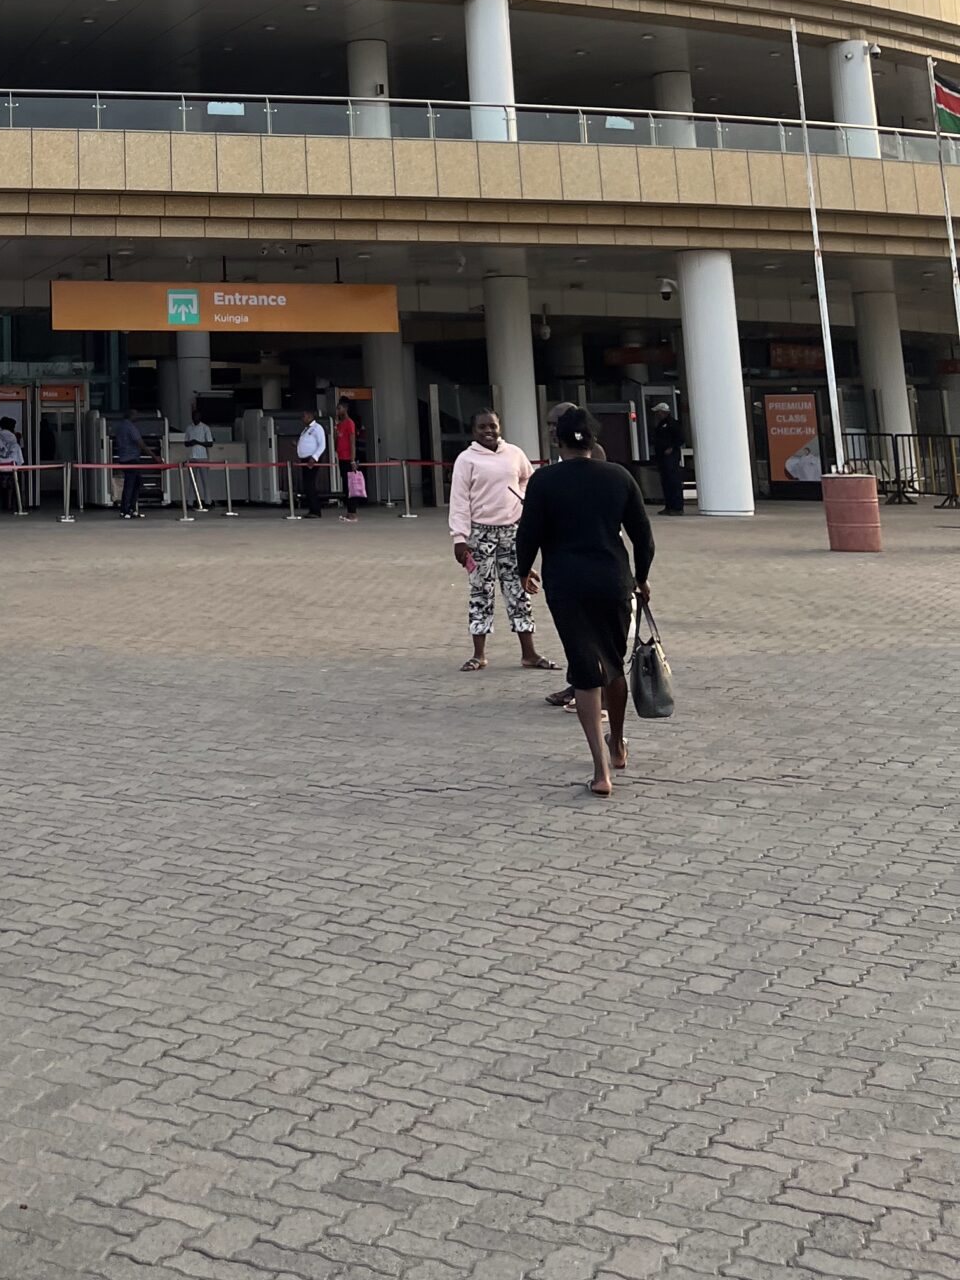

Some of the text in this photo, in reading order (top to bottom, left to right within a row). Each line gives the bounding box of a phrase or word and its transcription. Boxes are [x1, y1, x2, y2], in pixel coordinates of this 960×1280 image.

[213, 291, 287, 306] Entrance
[214, 313, 249, 324] Kuingia
[768, 401, 812, 409] PREMIUM
[776, 414, 807, 423] CLASS
[770, 426, 816, 436] CHECK-IN
